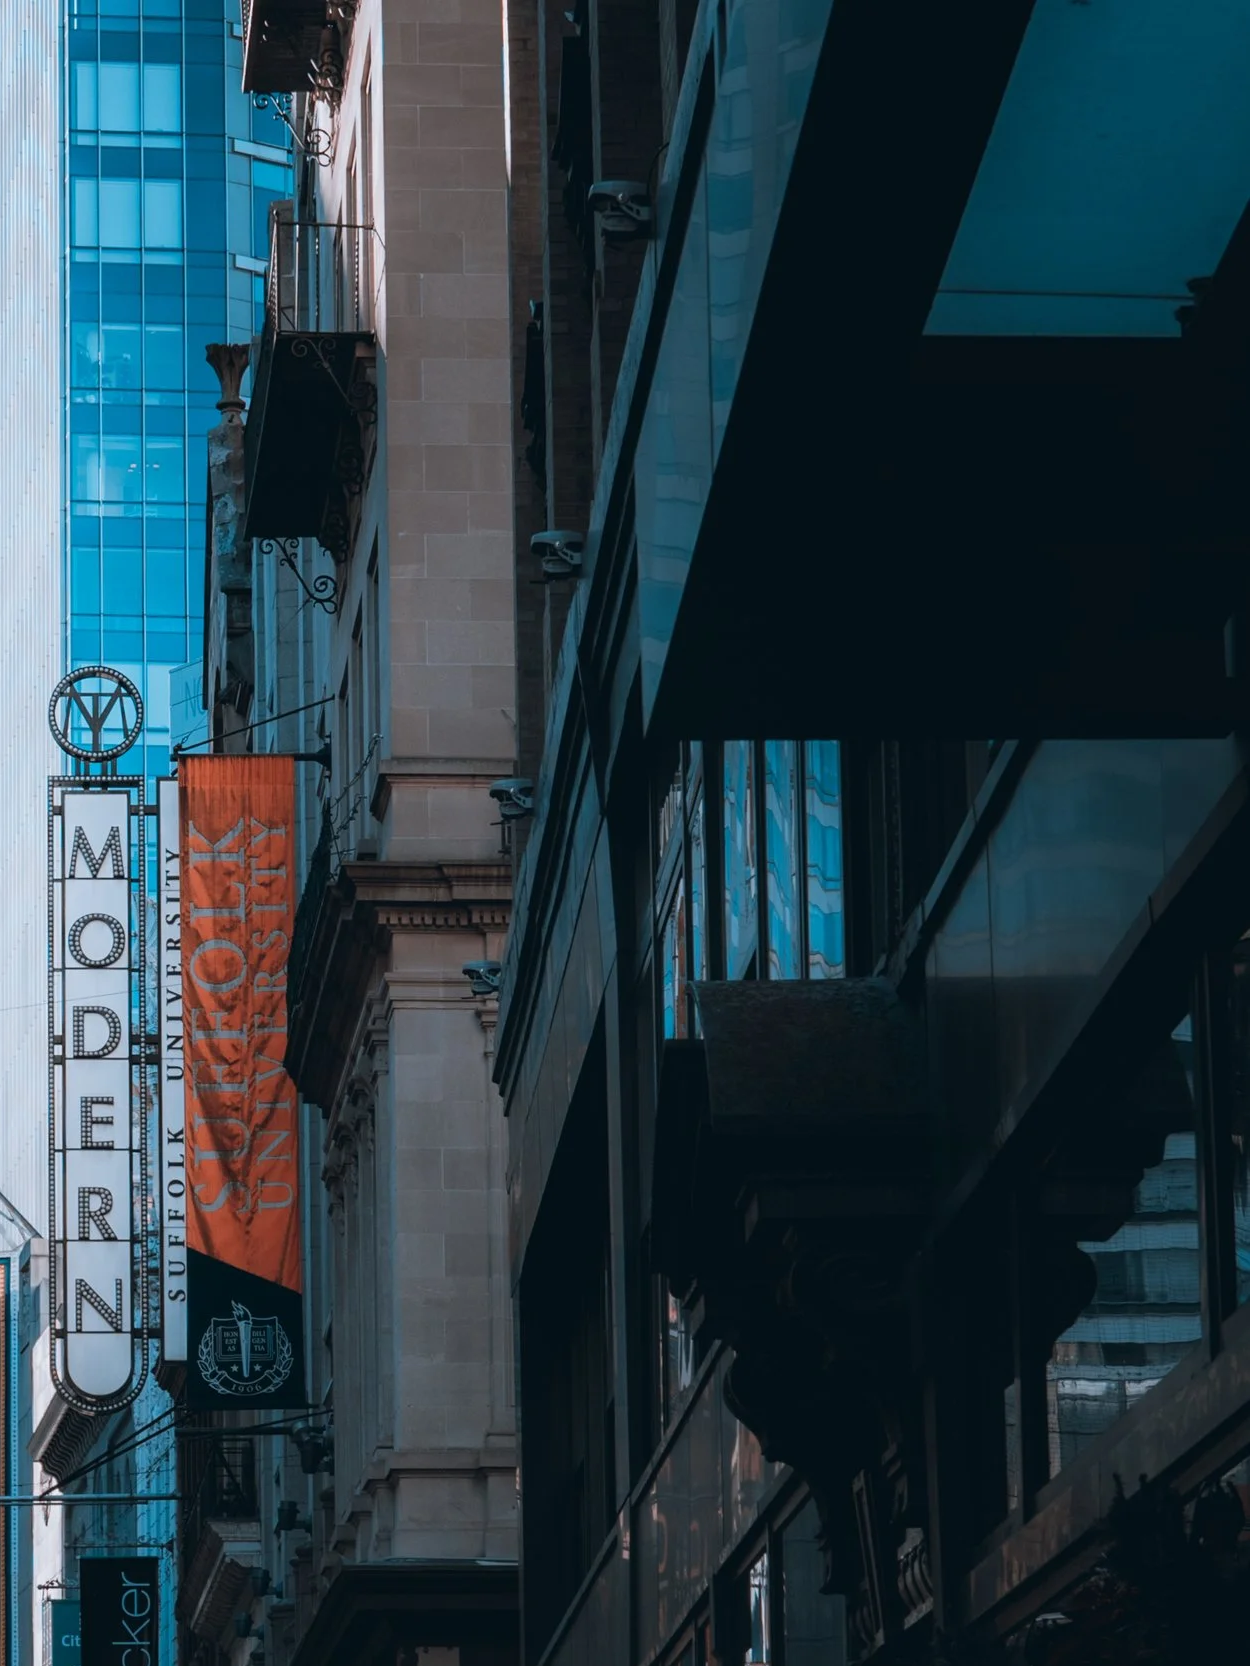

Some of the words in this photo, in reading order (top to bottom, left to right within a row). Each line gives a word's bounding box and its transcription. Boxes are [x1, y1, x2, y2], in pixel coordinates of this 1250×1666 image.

[68, 825, 125, 1332] MODERN
[163, 846, 184, 1083] UNIVERSITY
[188, 815, 252, 1216] SUFFOLK
[249, 815, 293, 1213] UNIVERSITY
[166, 1127, 186, 1303] SUFFOLK
[231, 1383, 263, 1393] 1906
